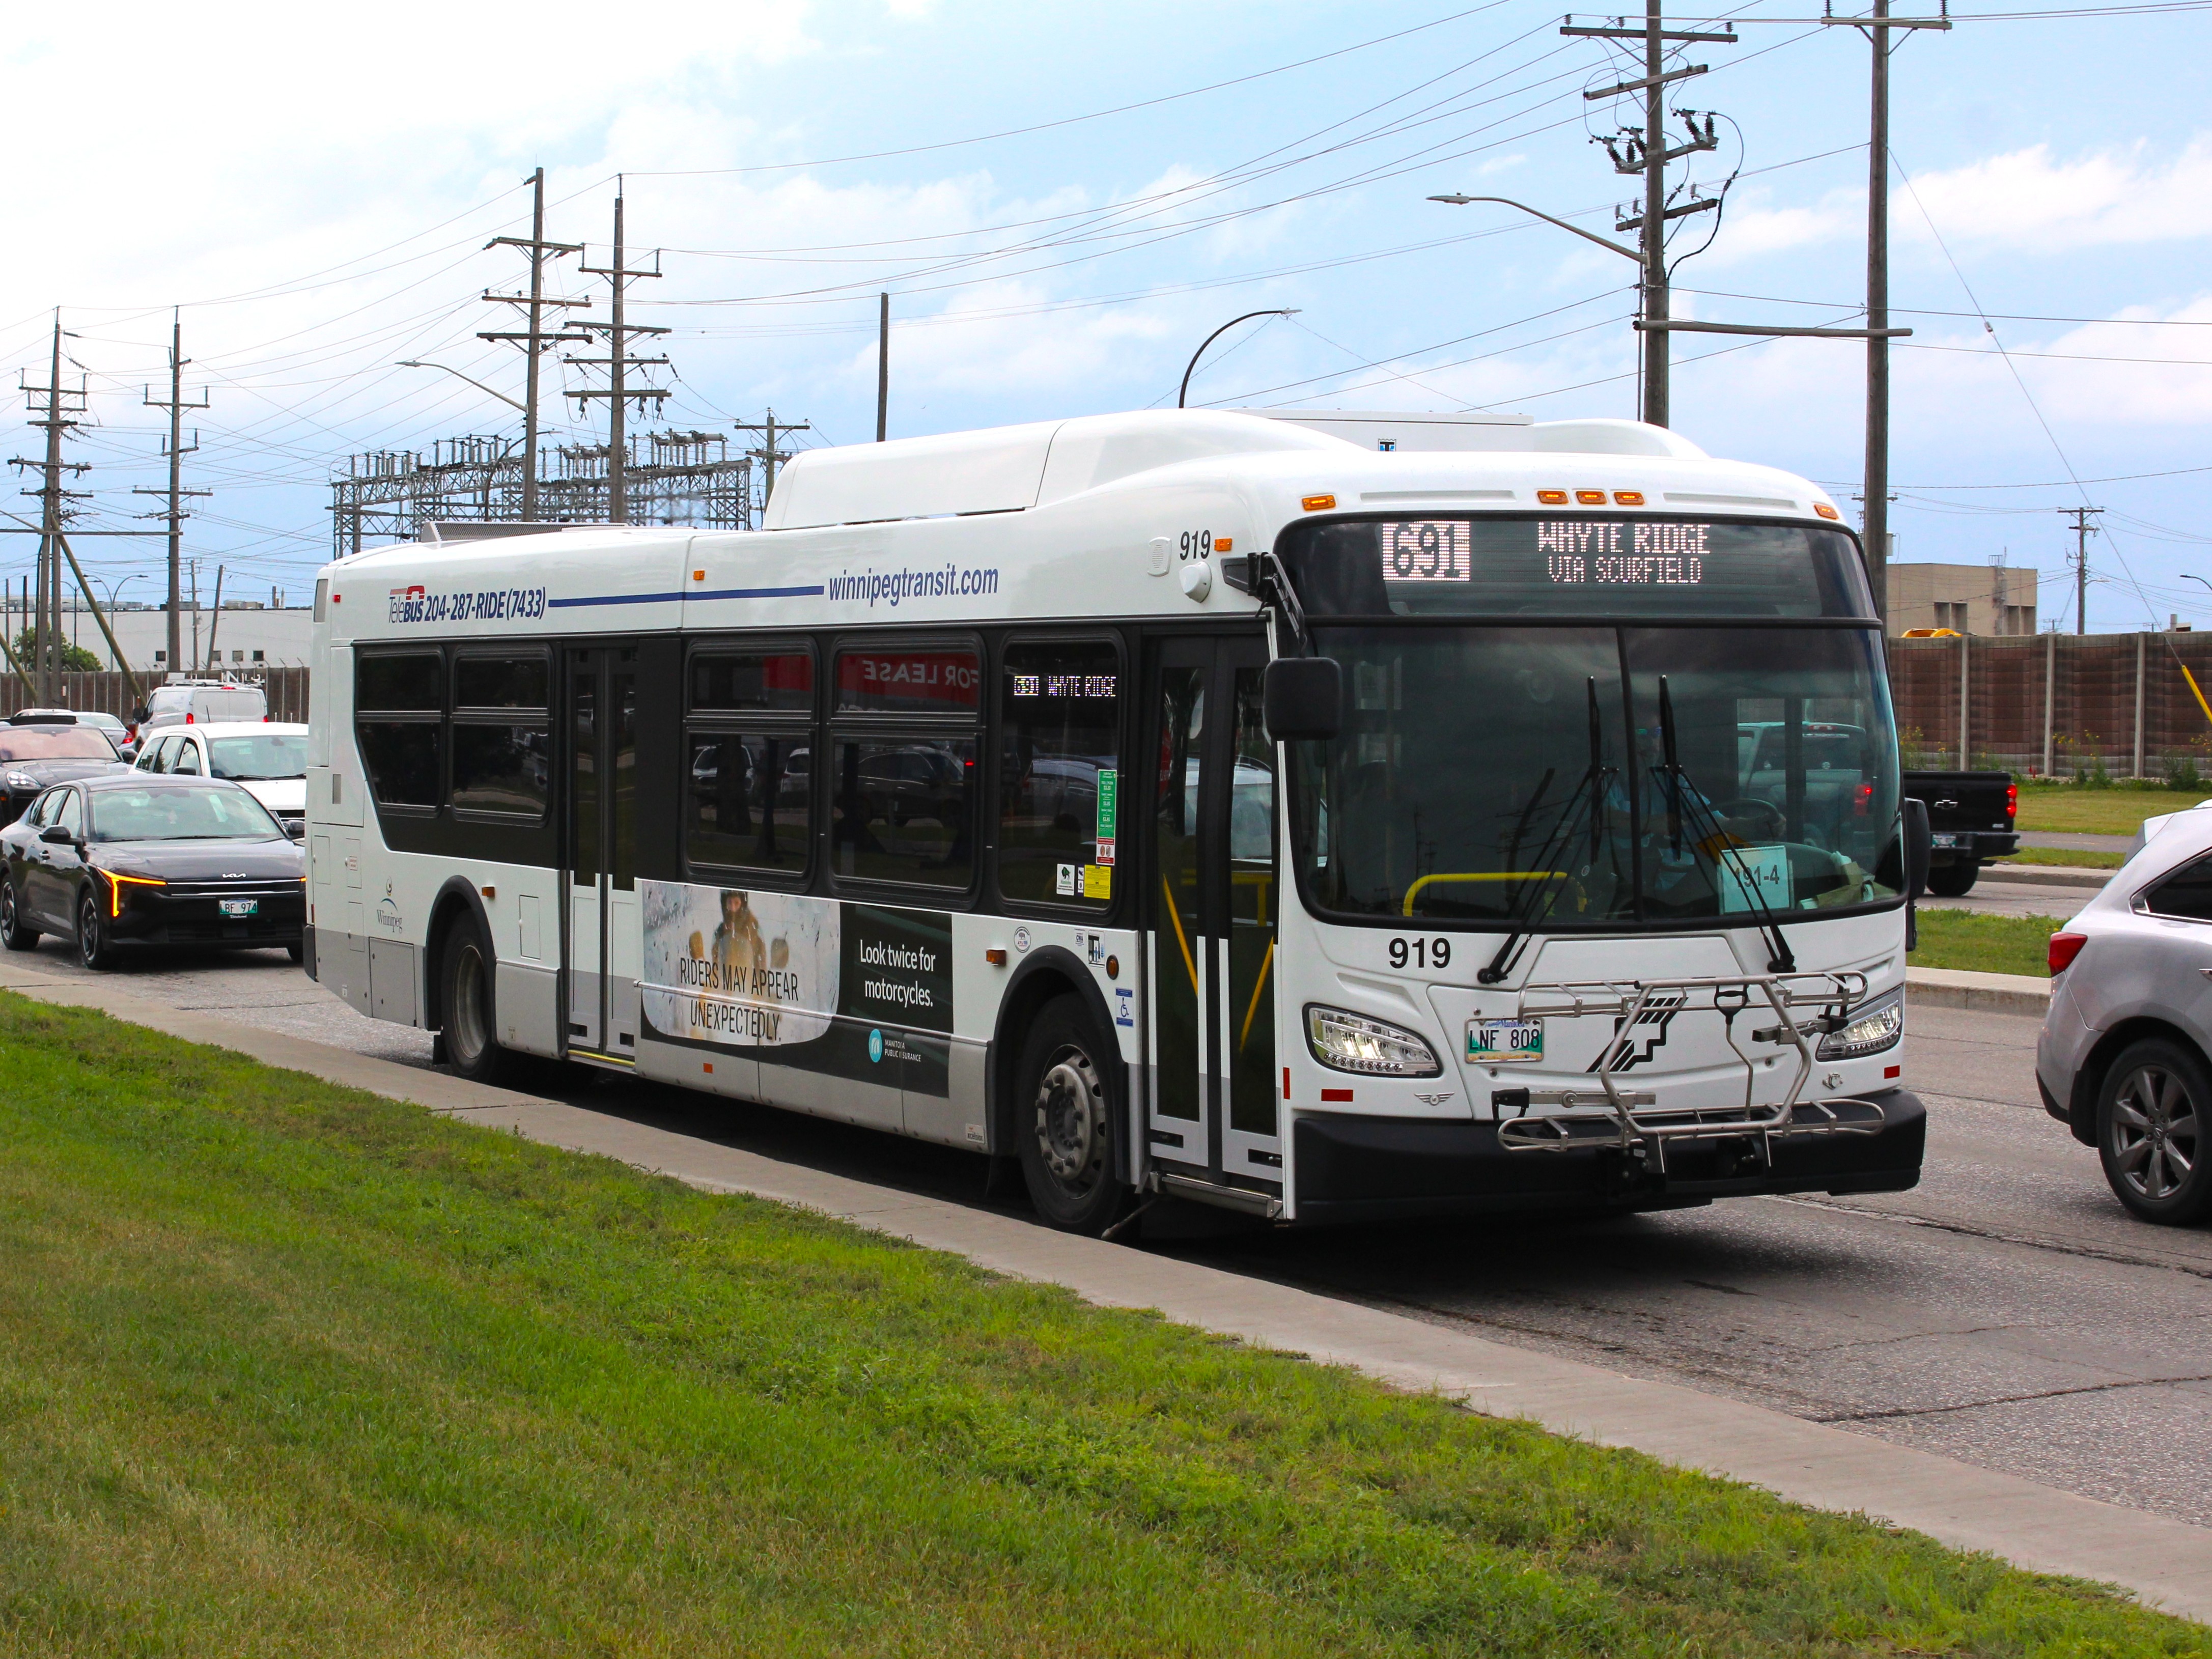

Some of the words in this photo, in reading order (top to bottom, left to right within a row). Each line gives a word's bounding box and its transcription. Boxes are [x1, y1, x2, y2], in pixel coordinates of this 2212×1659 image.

[1180, 529, 1211, 560] 919
[1391, 522, 1462, 579] 691
[1538, 522, 1623, 552] WHYTE
[1634, 523, 1711, 554] RIDGE
[829, 563, 999, 607] winnipegtransit.com
[1548, 555, 1585, 582] VIA
[1595, 556, 1701, 584] SCURFIELD
[388, 595, 424, 623] TeleBUS
[377, 909, 403, 934] Winnipeg
[860, 939, 886, 966] Look
[887, 943, 918, 970] twice
[918, 946, 936, 972] for
[1388, 937, 1451, 969] 919
[680, 957, 719, 990] RIDERS
[722, 963, 747, 993] MAY
[751, 968, 799, 1001] APPEAR
[864, 978, 934, 1008] motorcycles.
[690, 999, 782, 1042] UNEXPECTEDLY.
[1469, 1029, 1499, 1050] LNF
[1510, 1028, 1540, 1049] 808
[885, 1049, 899, 1058] PUBLIC
[899, 1051, 921, 1062] ISURANCE
